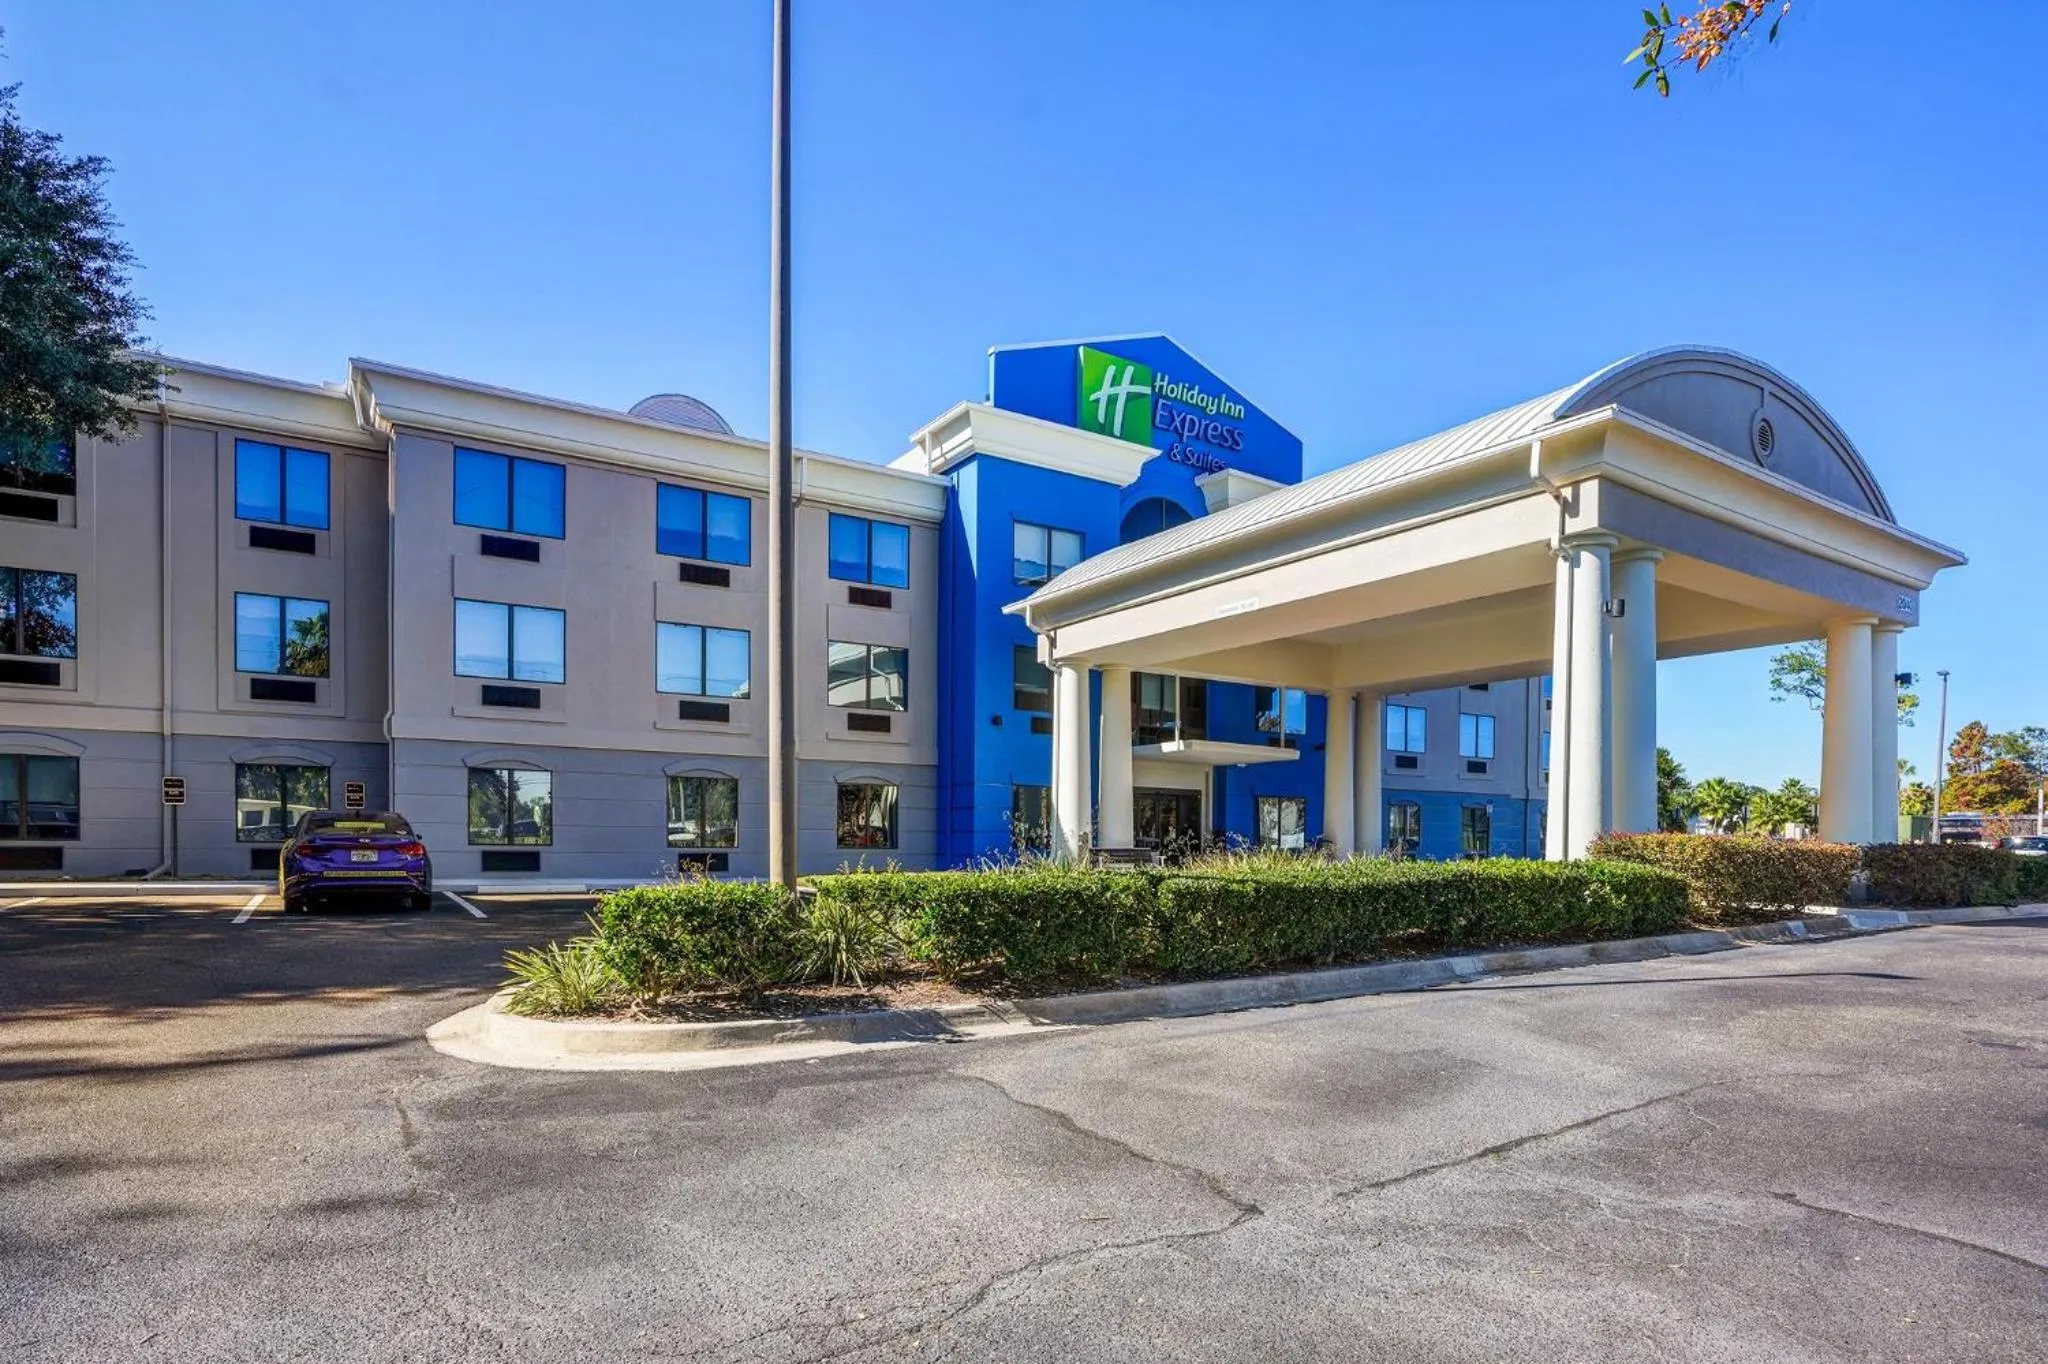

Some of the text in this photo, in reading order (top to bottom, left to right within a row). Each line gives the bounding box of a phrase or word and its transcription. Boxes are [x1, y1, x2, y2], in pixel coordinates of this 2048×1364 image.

[1089, 365, 1151, 437] H
[1154, 372, 1244, 419] Holiday Inn
[1155, 398, 1244, 450] Express
[1171, 443, 1183, 462] &
